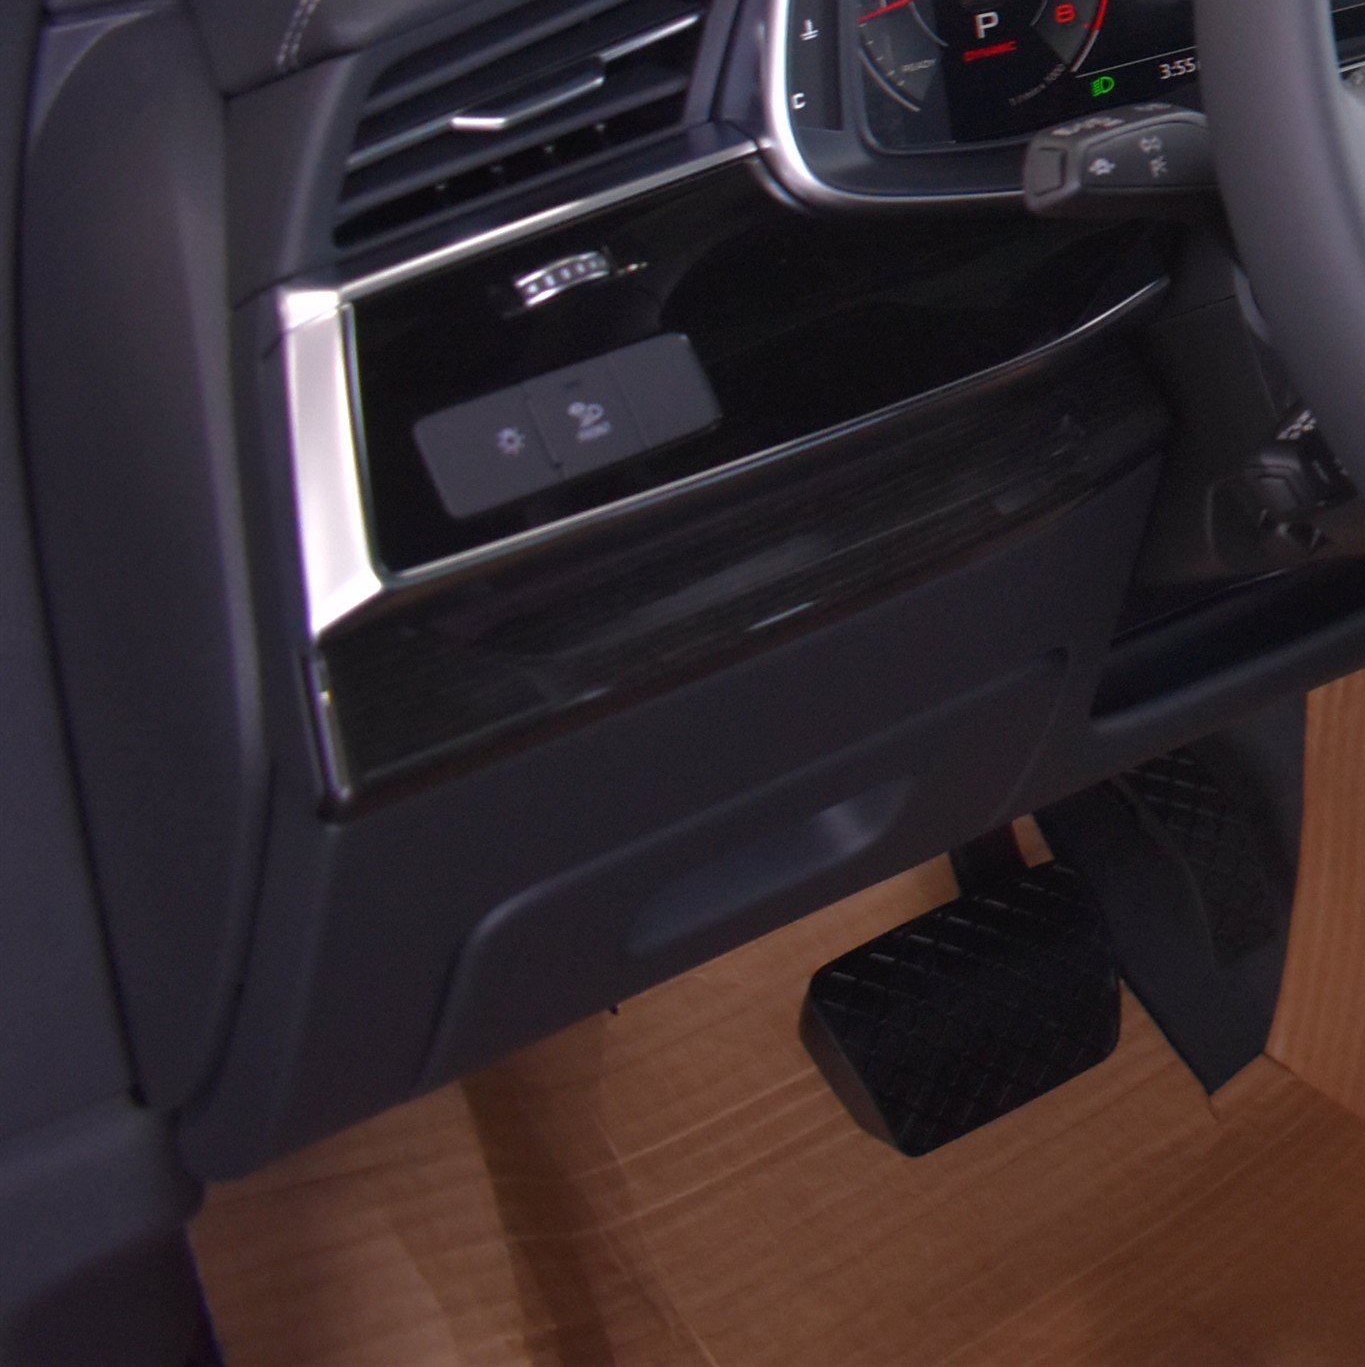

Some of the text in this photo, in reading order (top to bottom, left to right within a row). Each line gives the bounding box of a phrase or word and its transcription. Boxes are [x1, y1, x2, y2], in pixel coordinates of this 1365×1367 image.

[1055, 3, 1077, 24] 8
[974, 11, 999, 39] P
[791, 92, 806, 110] C
